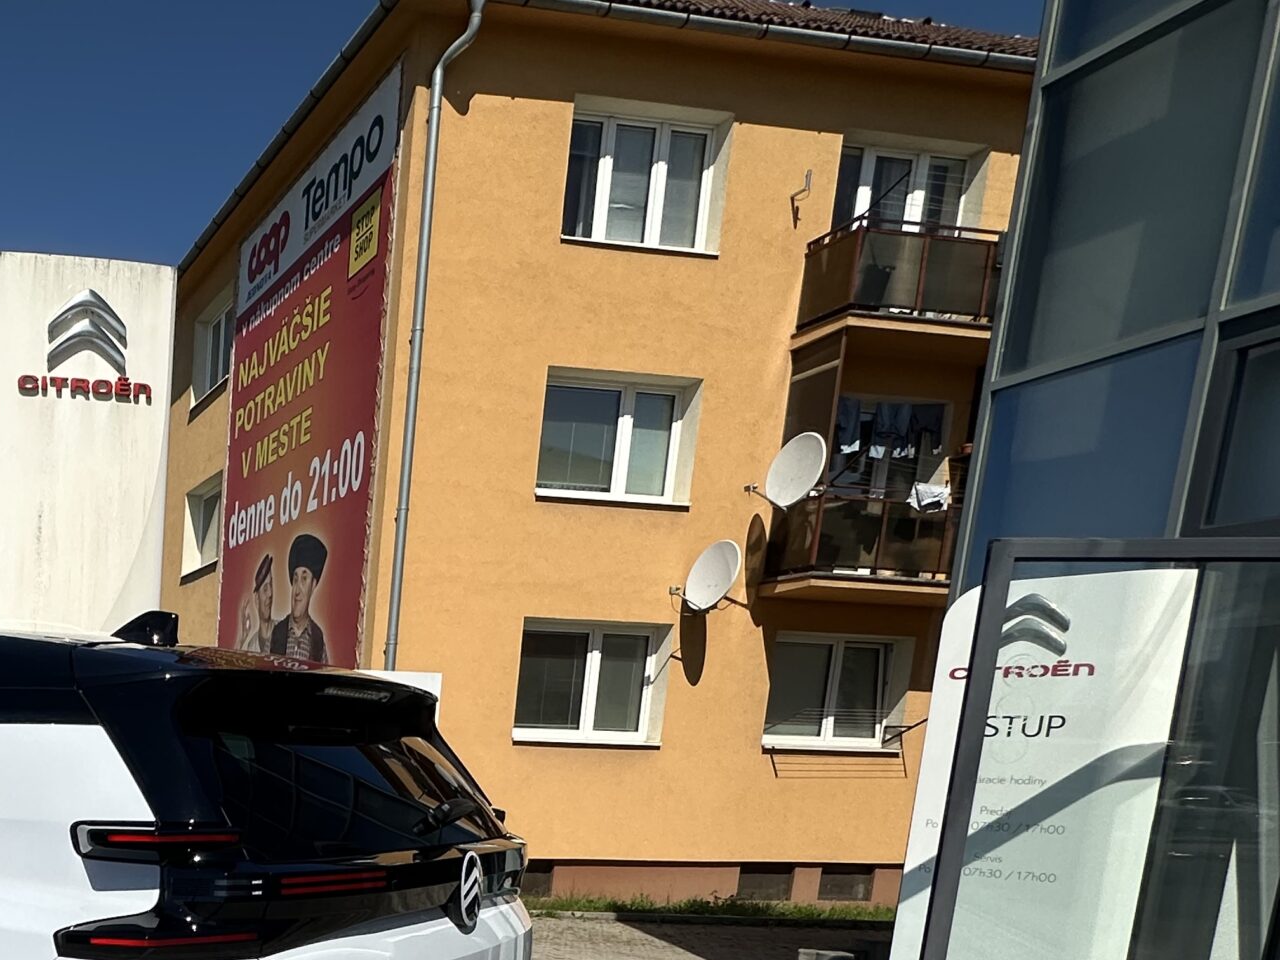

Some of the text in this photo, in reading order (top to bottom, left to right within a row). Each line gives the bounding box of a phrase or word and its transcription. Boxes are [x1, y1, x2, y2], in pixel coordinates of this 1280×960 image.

[302, 114, 384, 231] Tempo
[355, 205, 375, 236] STOP
[354, 231, 374, 262] SHOP
[249, 271, 300, 332] nákupnom
[303, 233, 341, 281] centre
[237, 285, 332, 392] NAJVÄČŠIE
[17, 374, 152, 405] CITROËN
[234, 341, 330, 439] POTRAVINY
[241, 407, 313, 479] V MESTE
[228, 430, 365, 550] denne do 21:00
[948, 659, 1096, 681] CROËN
[983, 714, 1066, 738] STUP
[1009, 774, 1047, 788] hodiny
[925, 818, 939, 829] Po
[970, 821, 1010, 834] 07h30
[1025, 822, 1066, 836] 17h00
[973, 851, 1003, 864] Servis
[962, 866, 1002, 880] 07h30
[1016, 870, 1058, 884] 17h00
